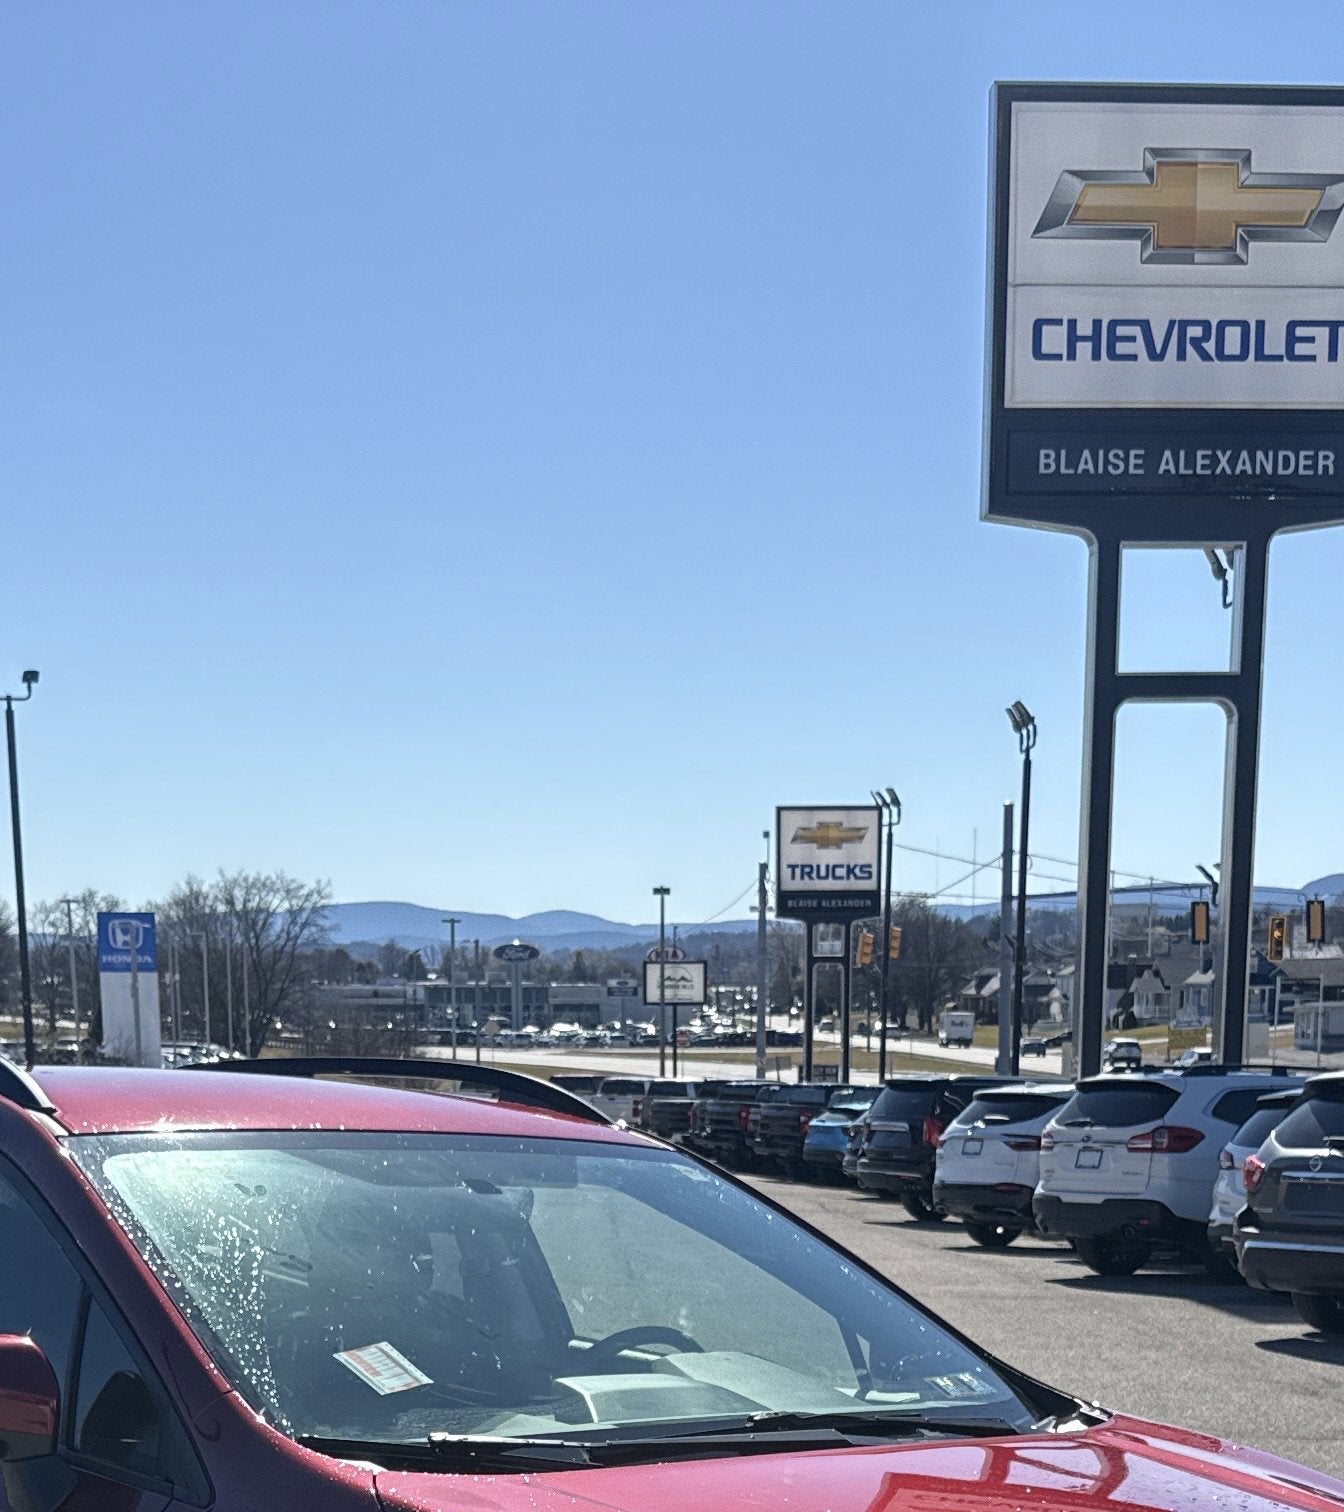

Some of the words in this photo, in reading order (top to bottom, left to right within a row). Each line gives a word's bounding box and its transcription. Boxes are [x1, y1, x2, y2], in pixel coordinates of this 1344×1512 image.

[1038, 449, 1145, 474] BLAISE
[1157, 450, 1335, 475] ALEXANDER
[786, 864, 872, 881] TRUCKS
[787, 899, 817, 908] BLAISE
[821, 899, 871, 908] ALEXANDER
